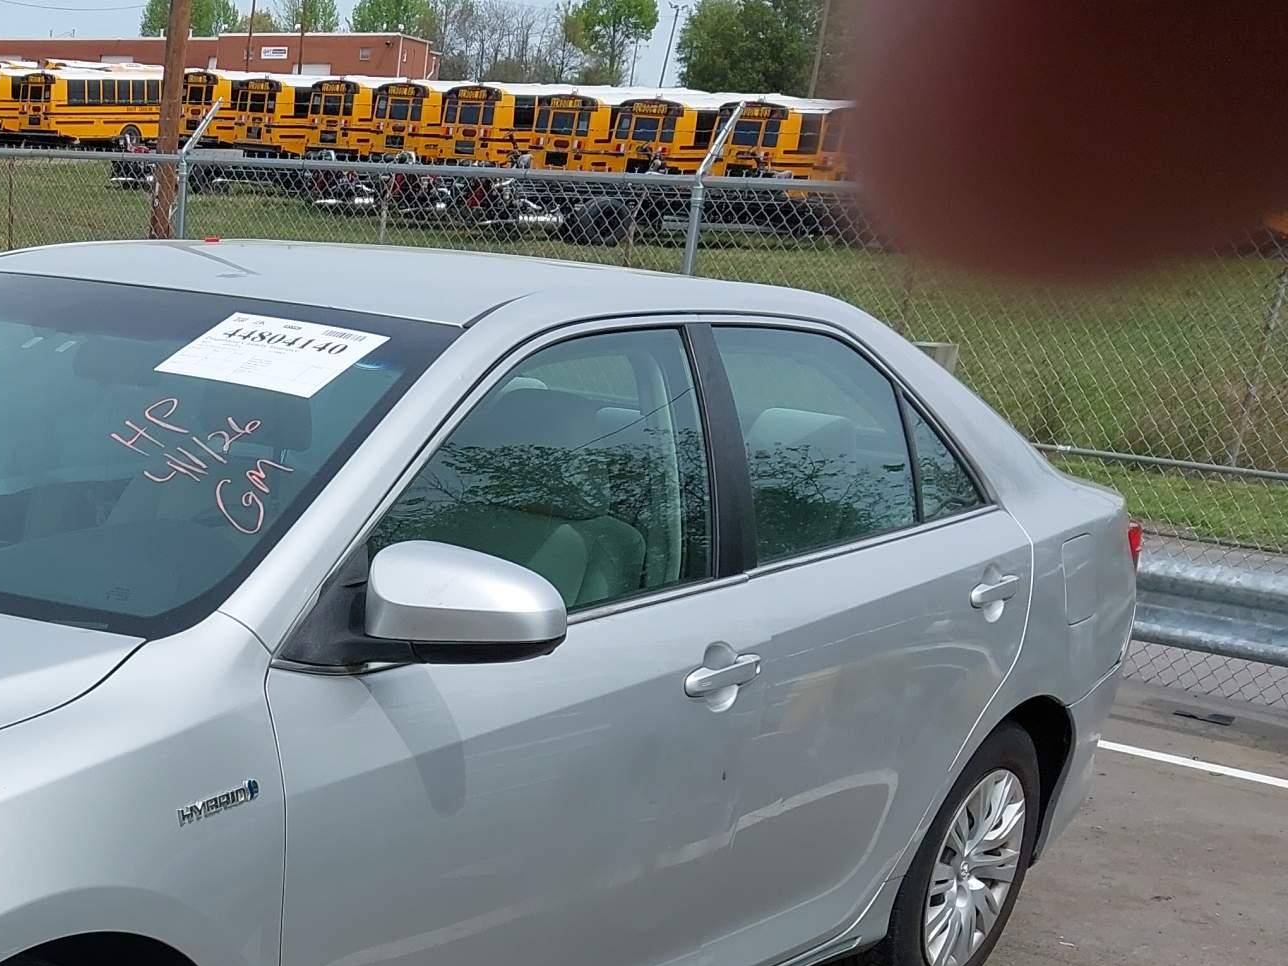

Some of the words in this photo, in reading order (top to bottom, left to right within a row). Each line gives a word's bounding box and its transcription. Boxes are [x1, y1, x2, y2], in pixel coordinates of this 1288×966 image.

[223, 326, 349, 356] 44804140
[110, 397, 189, 456] HP
[176, 786, 249, 827] HYBRID
